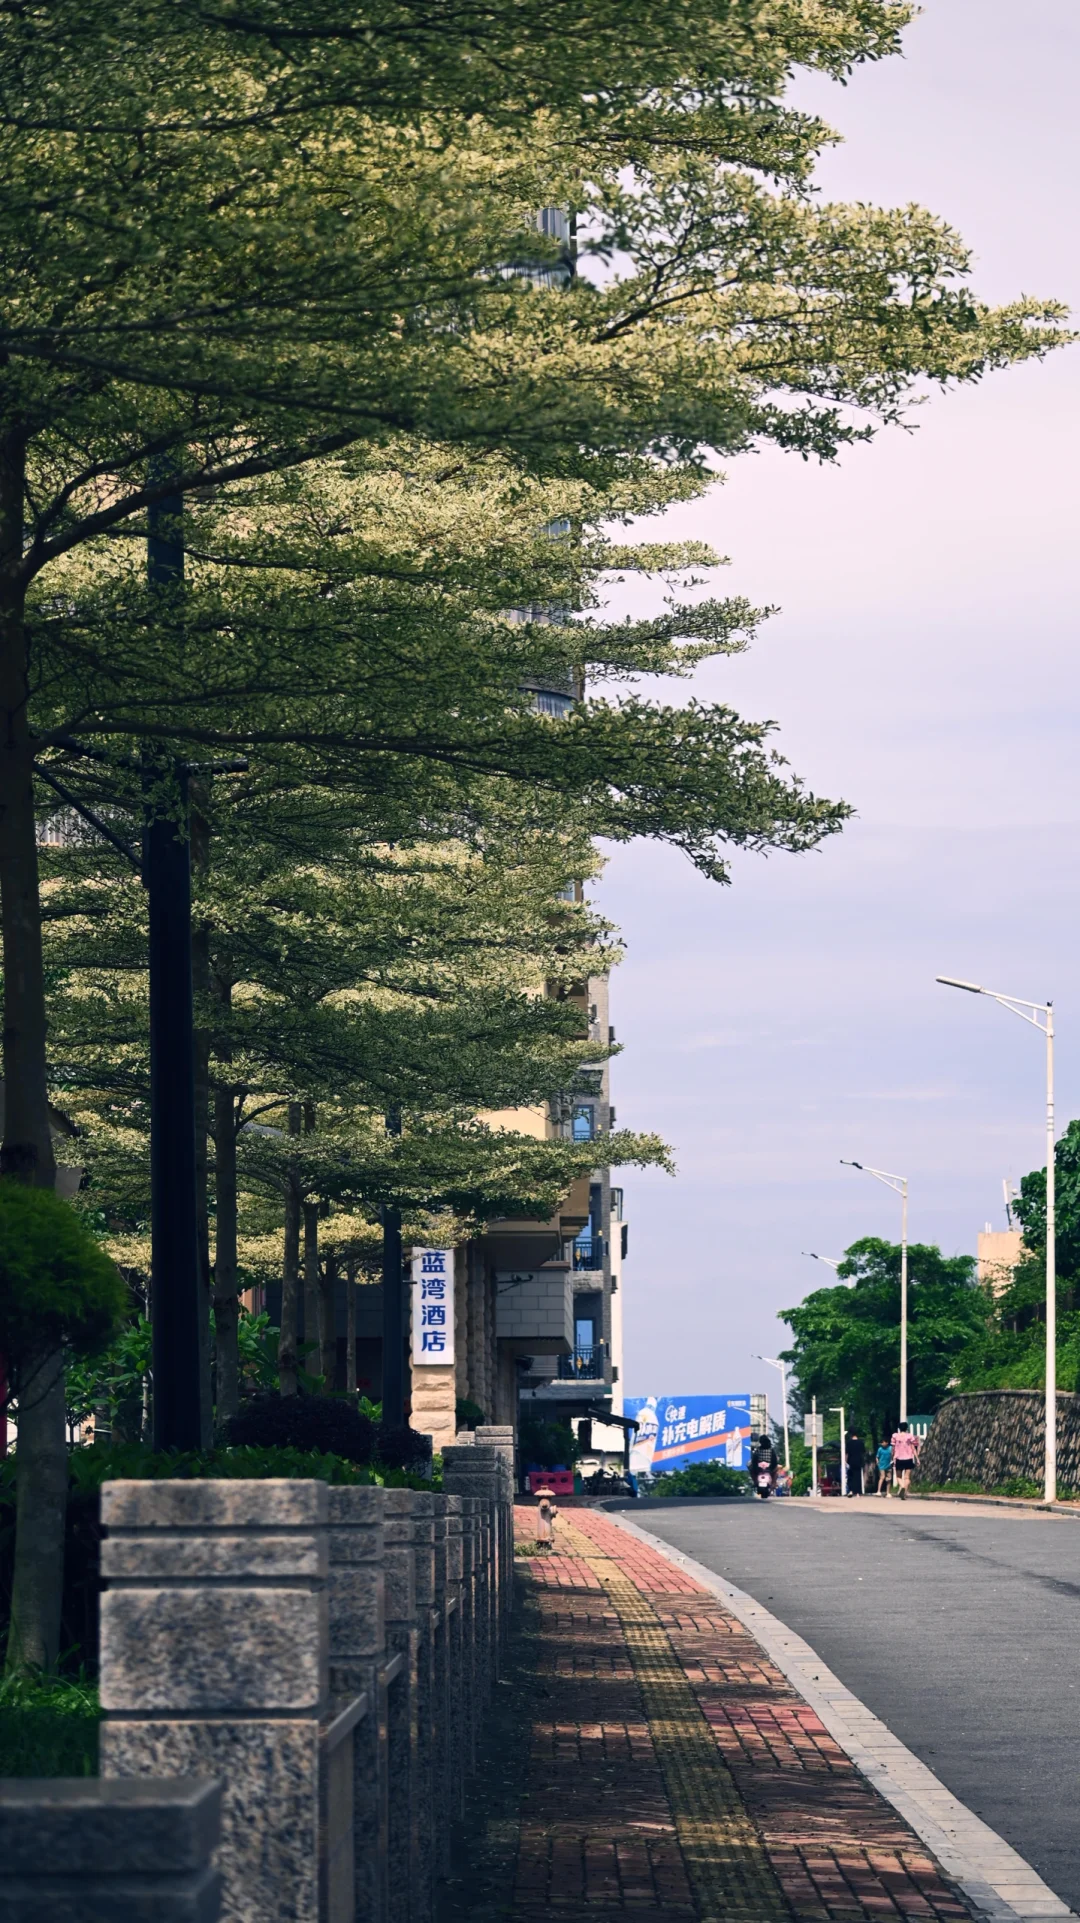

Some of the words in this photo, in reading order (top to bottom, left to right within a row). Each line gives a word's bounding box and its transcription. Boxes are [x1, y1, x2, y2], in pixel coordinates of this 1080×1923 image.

[421, 1251, 446, 1352] 蓝湾酒店
[661, 1409, 727, 1447] 补充电解质
[667, 1405, 687, 1422] 快速
